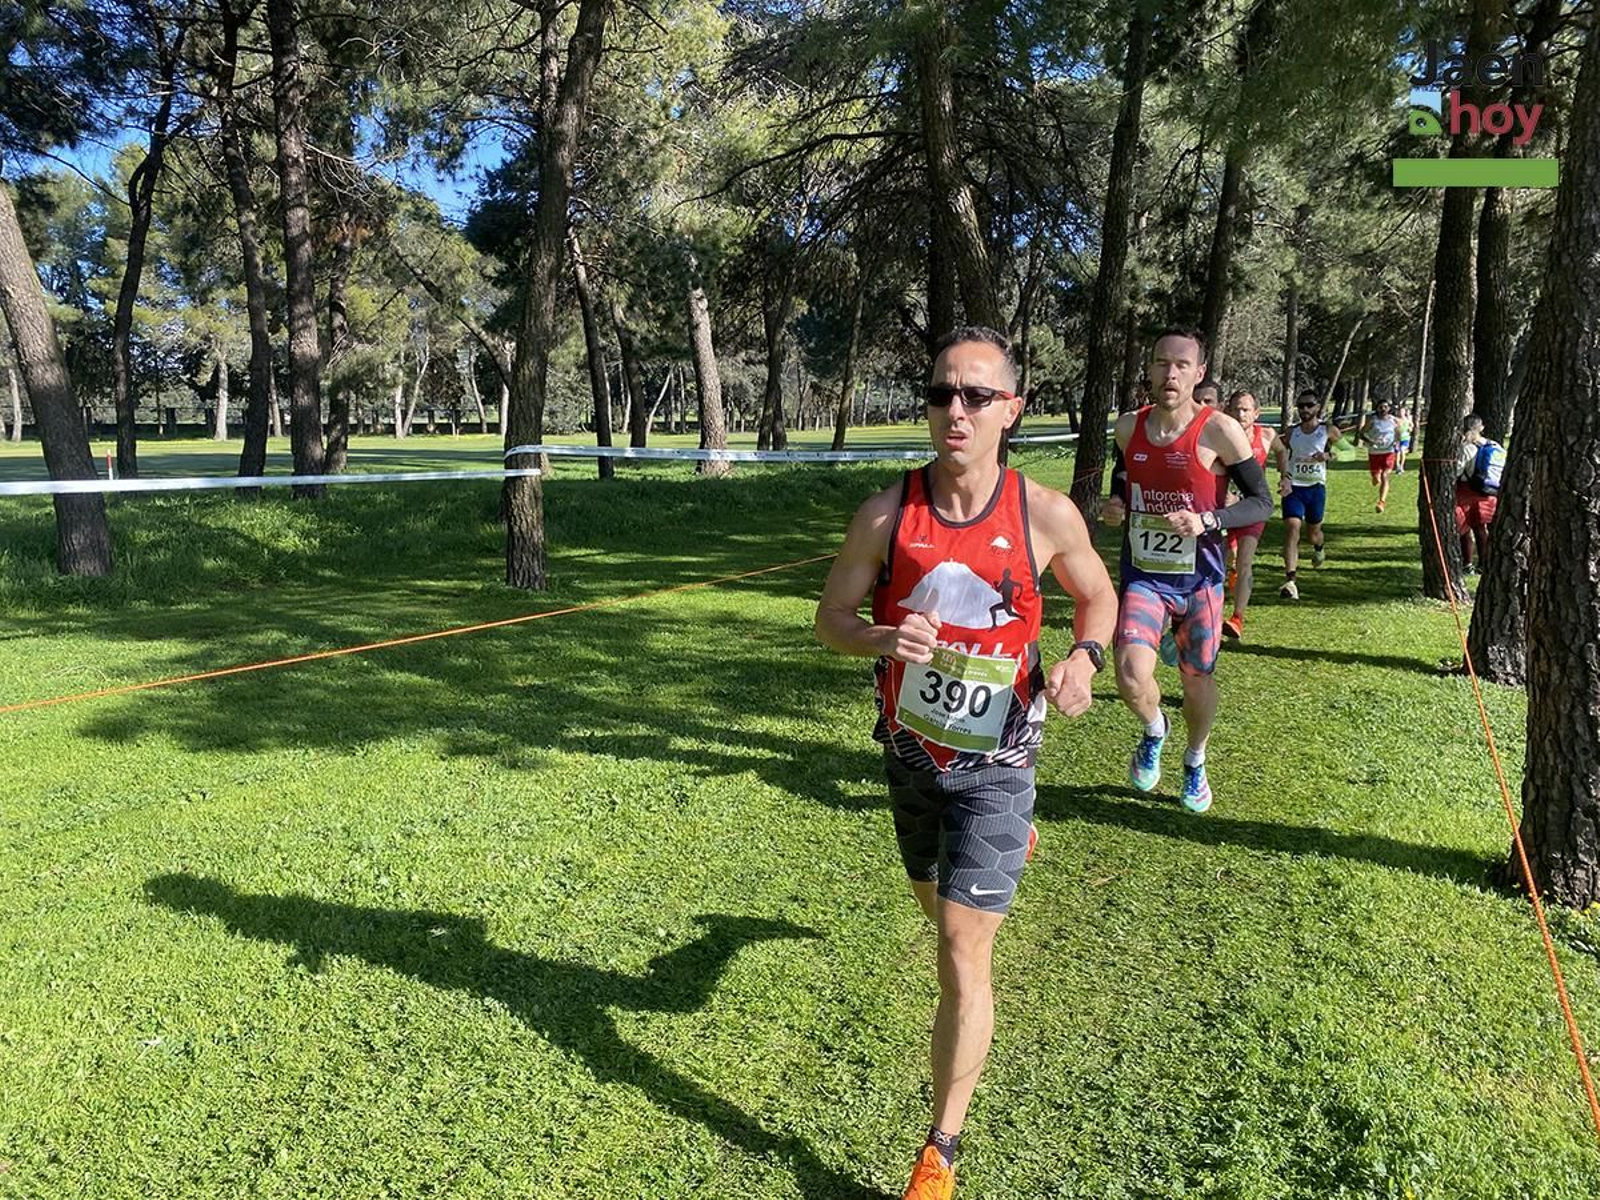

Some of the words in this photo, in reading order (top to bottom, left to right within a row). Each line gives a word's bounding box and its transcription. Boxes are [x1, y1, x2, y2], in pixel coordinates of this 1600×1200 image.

[1131, 482, 1194, 505] Antorcha
[1139, 531, 1183, 554] 122
[919, 670, 992, 718] 390
